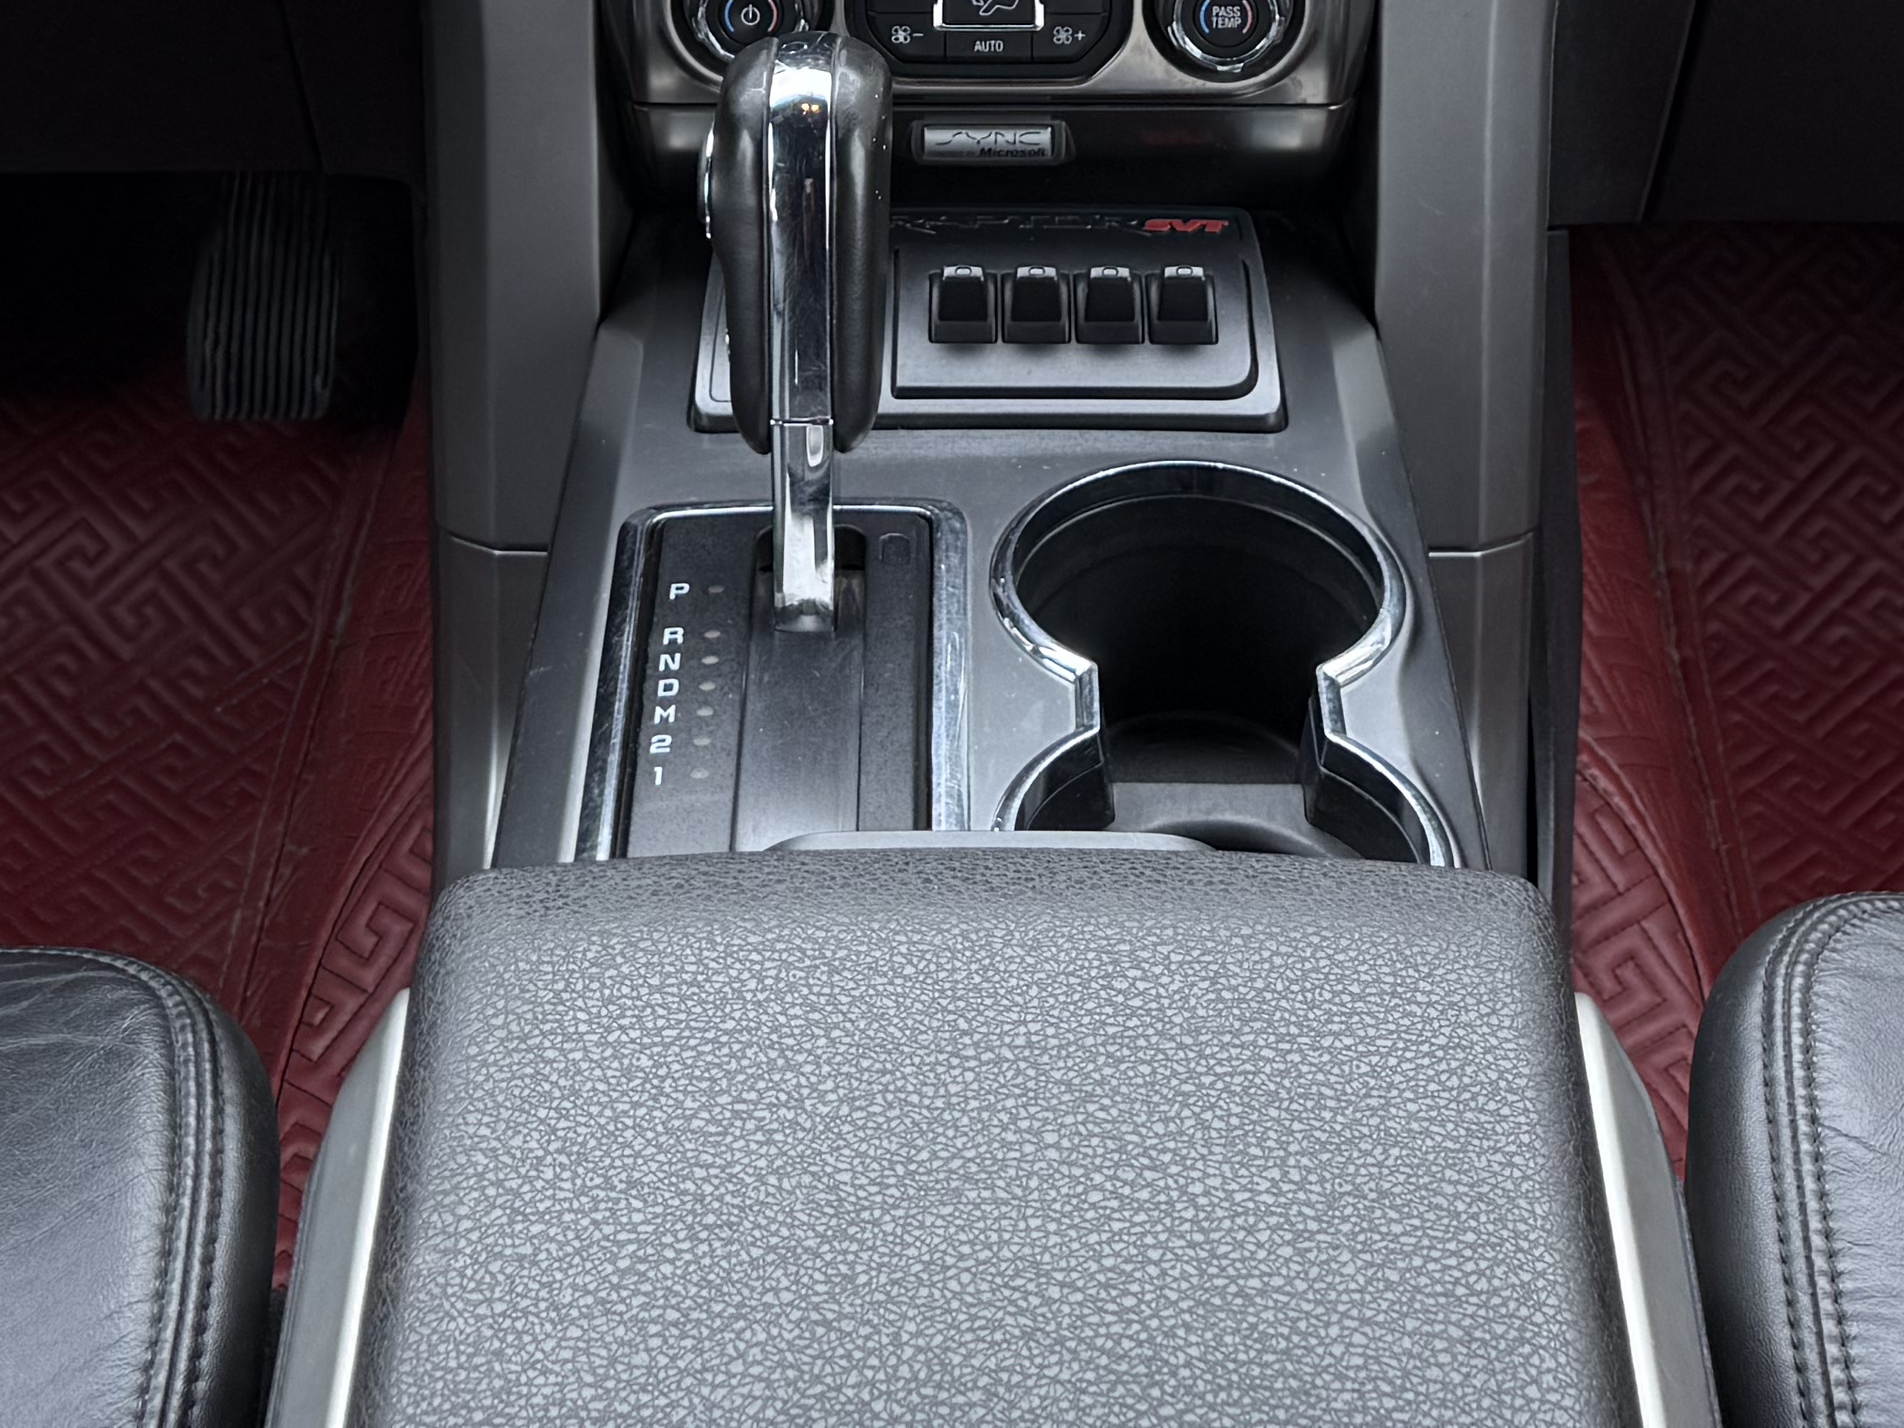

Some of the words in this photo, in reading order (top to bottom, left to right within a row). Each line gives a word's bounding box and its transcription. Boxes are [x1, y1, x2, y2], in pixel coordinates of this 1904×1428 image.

[1212, 6, 1241, 17] PASS
[1211, 17, 1242, 29] TEMP
[973, 40, 1004, 53] AUTO
[935, 131, 1042, 146] SYNC
[978, 146, 1047, 158] Microsoft
[1142, 219, 1229, 234] SVT
[669, 582, 690, 600] P
[662, 627, 684, 646] R
[658, 653, 681, 671] N
[657, 679, 680, 697] D
[654, 705, 676, 724] M
[650, 734, 672, 754] 2
[654, 766, 663, 786] 1
